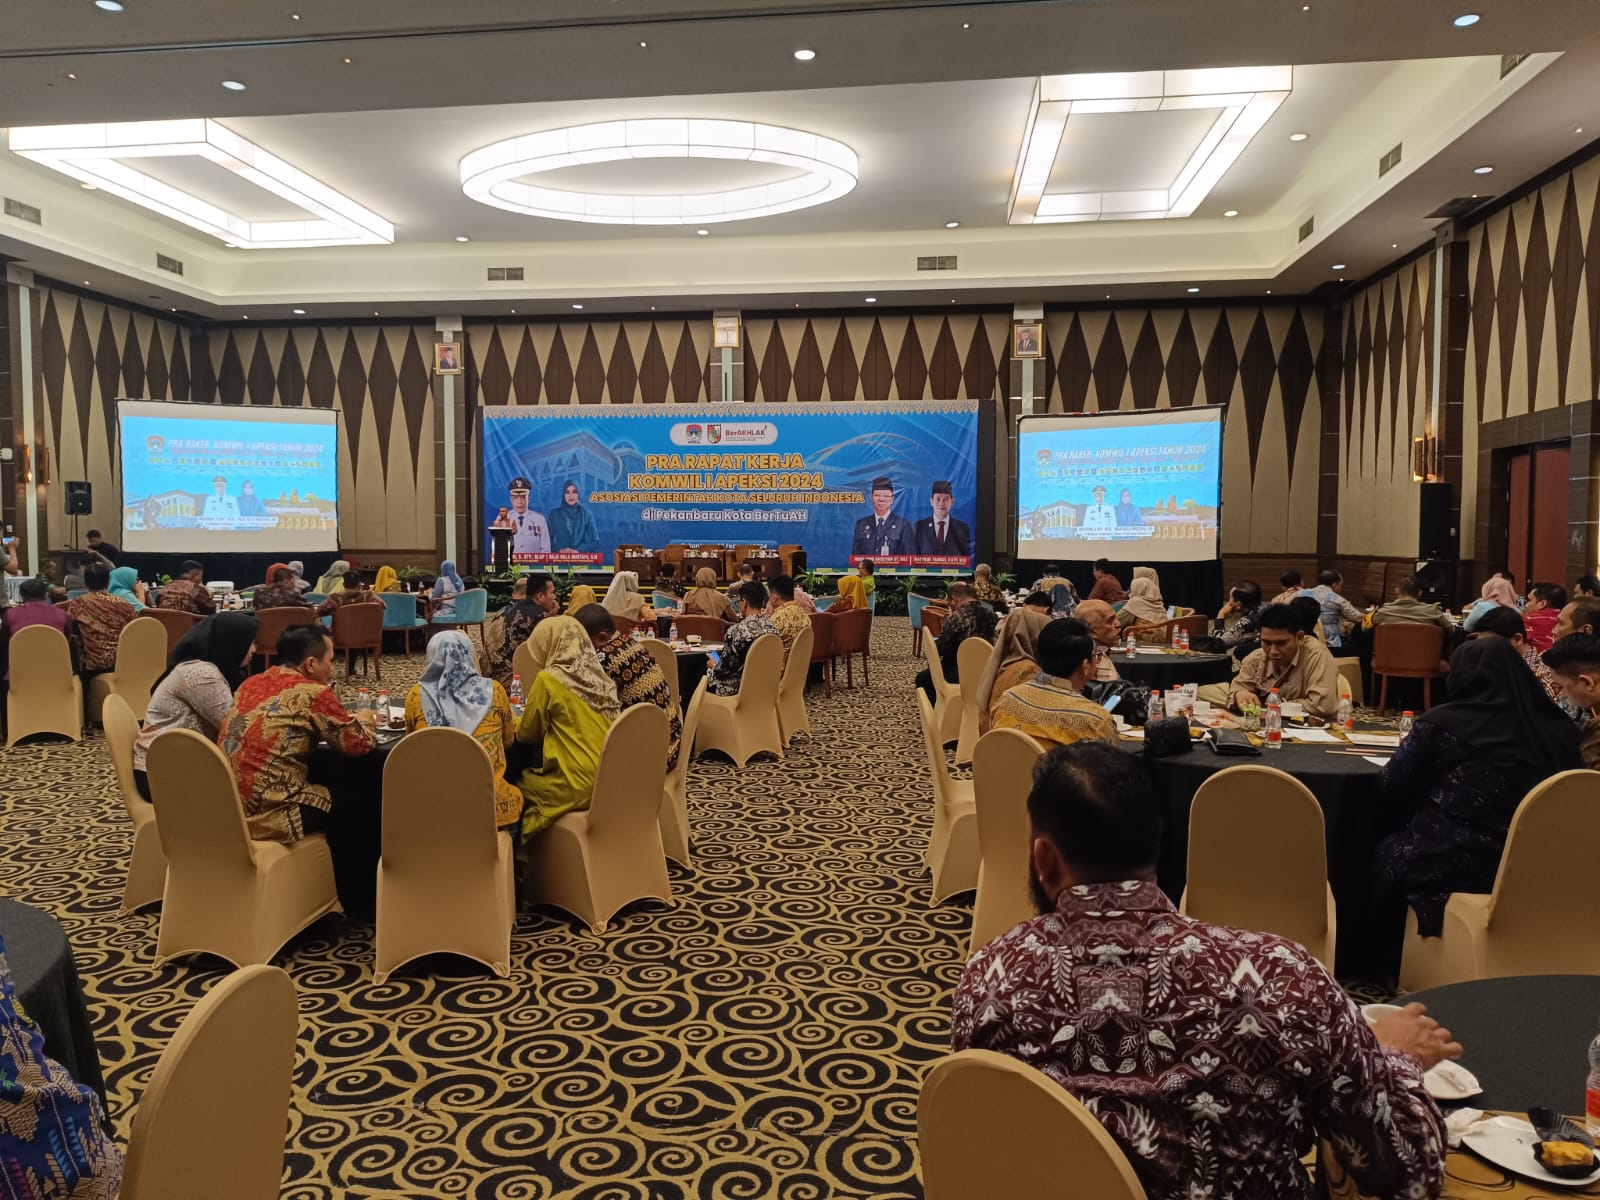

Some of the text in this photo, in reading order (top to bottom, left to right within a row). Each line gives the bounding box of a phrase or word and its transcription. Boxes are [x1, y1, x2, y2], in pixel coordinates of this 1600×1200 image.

[725, 429, 766, 437] BerAKHLAK
[646, 454, 805, 469] PRA RAPAT KERJA
[628, 473, 704, 489] KOMWIL
[714, 473, 778, 489] APEKSI
[780, 473, 823, 489] 2024
[590, 492, 864, 503] ASOSIASI PEMERINTAH KOTA SELURUH INDONESIA
[642, 508, 807, 520] di Pekanbaru Kota BerTuAH
